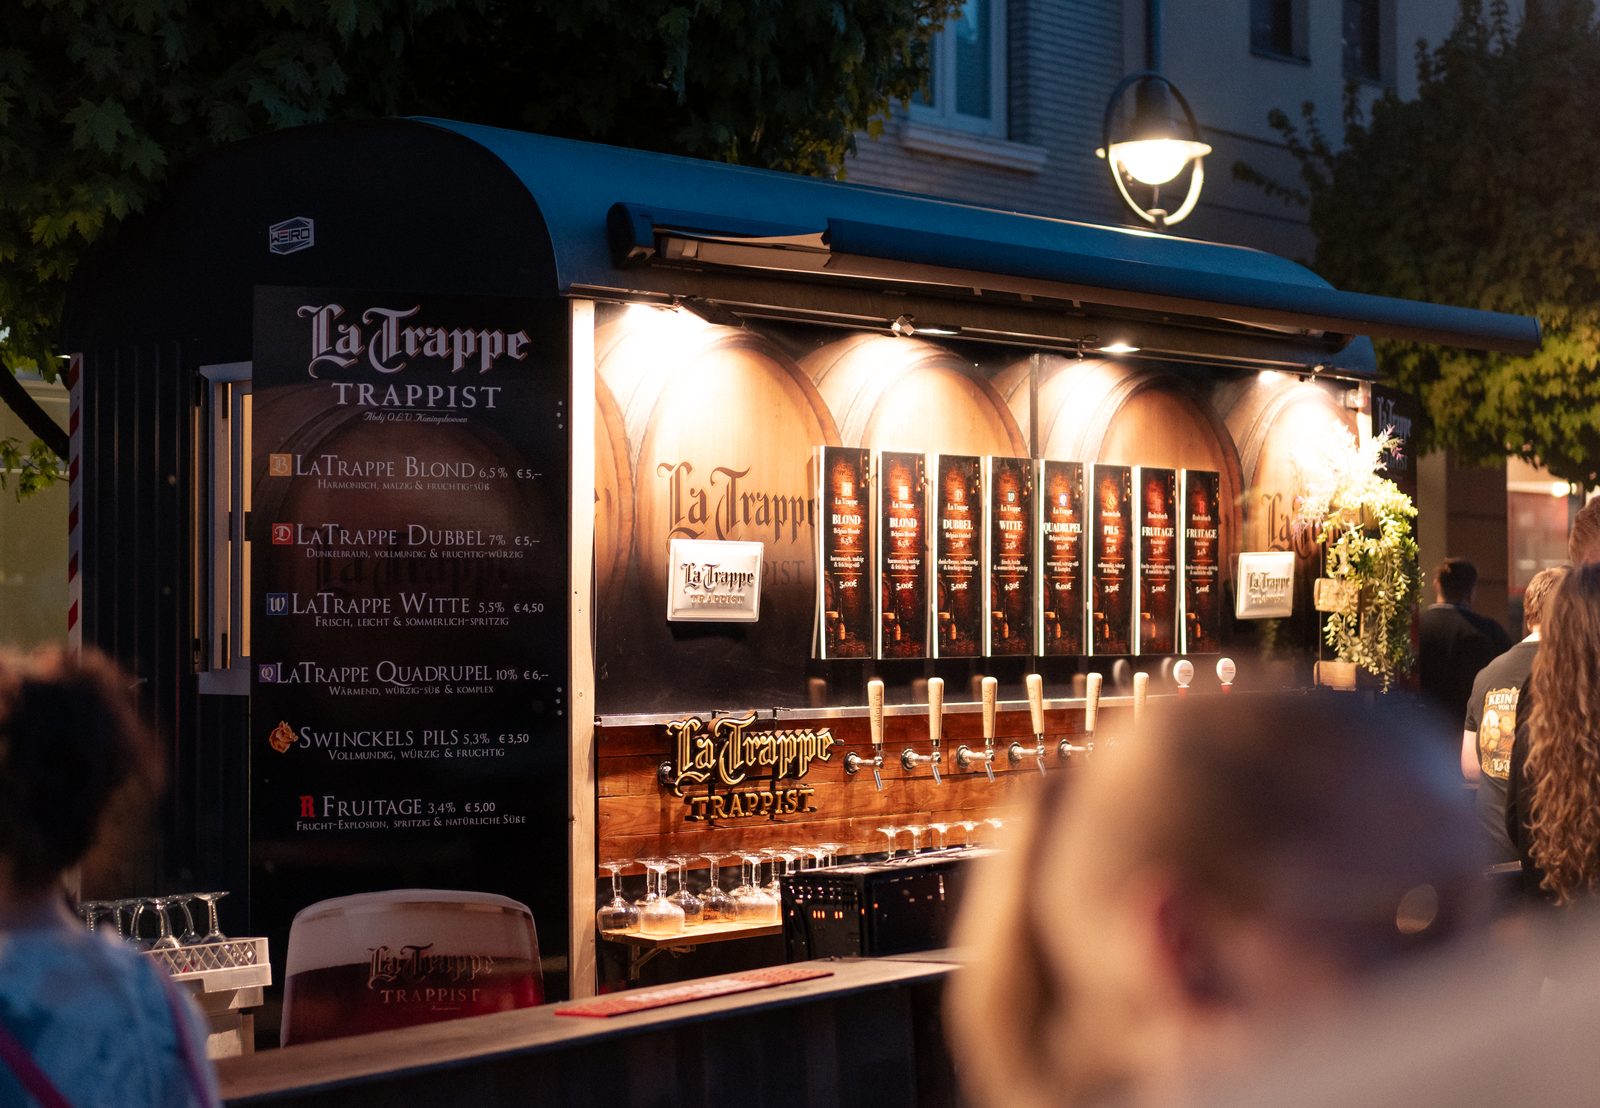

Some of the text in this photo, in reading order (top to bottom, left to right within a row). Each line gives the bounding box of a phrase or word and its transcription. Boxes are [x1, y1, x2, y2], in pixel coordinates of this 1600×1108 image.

[297, 303, 532, 379] La Trappe
[331, 382, 502, 410] TRAPPIST
[414, 480, 424, 490] &
[832, 514, 861, 525] BLOND
[889, 517, 918, 528] BLOND
[943, 519, 973, 530] DUBBEL
[999, 520, 1023, 531] WITTE
[1103, 525, 1119, 535] PILS
[1141, 526, 1174, 537] FRUITAGE
[1186, 528, 1217, 539] FRUITAGE
[488, 534, 506, 546] 7%
[429, 548, 438, 558] &
[701, 563, 755, 593] Trappe
[478, 602, 505, 614] 5,5%
[393, 616, 402, 626] &
[495, 669, 518, 681] 10%
[444, 684, 454, 694] &
[1488, 693, 1512, 705] KEIN
[463, 733, 490, 745] 5,3%
[444, 748, 453, 758] &
[666, 715, 717, 797] La
[708, 710, 835, 786] Trappe
[427, 802, 456, 815] 3,4%
[689, 788, 816, 820] TRAPPIST
[433, 817, 442, 827] &
[380, 988, 481, 1003] TRAPPIST
